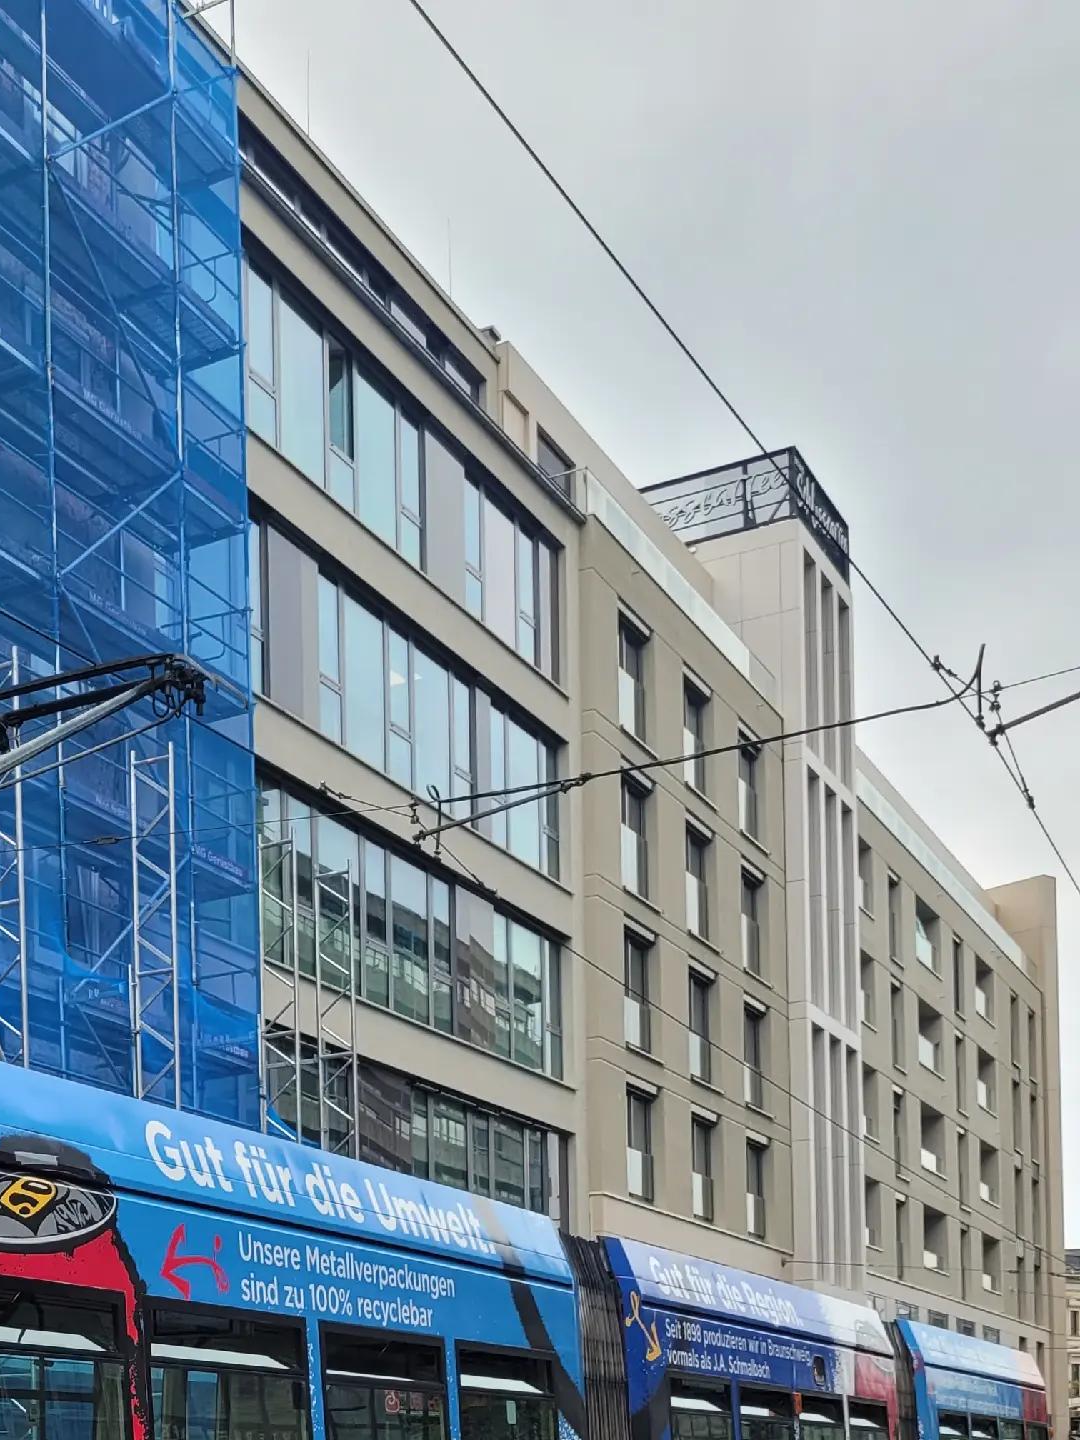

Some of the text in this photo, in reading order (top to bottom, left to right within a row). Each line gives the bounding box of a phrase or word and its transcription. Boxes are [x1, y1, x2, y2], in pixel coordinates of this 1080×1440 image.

[145, 1120, 497, 1256] Gut für die Umwelt.
[238, 1230, 456, 1301] Unsere Metallverpackungen
[649, 1256, 691, 1300] Gut
[685, 1264, 717, 1306] für
[716, 1273, 747, 1313] die
[240, 1272, 434, 1329] sind zu 100% recyclebar
[665, 1318, 682, 1339] Seit
[704, 1329, 748, 1352] produzieren
[749, 1335, 760, 1354] wir
[760, 1336, 768, 1355] in
[667, 1348, 700, 1370] vormals
[701, 1351, 712, 1370] als
